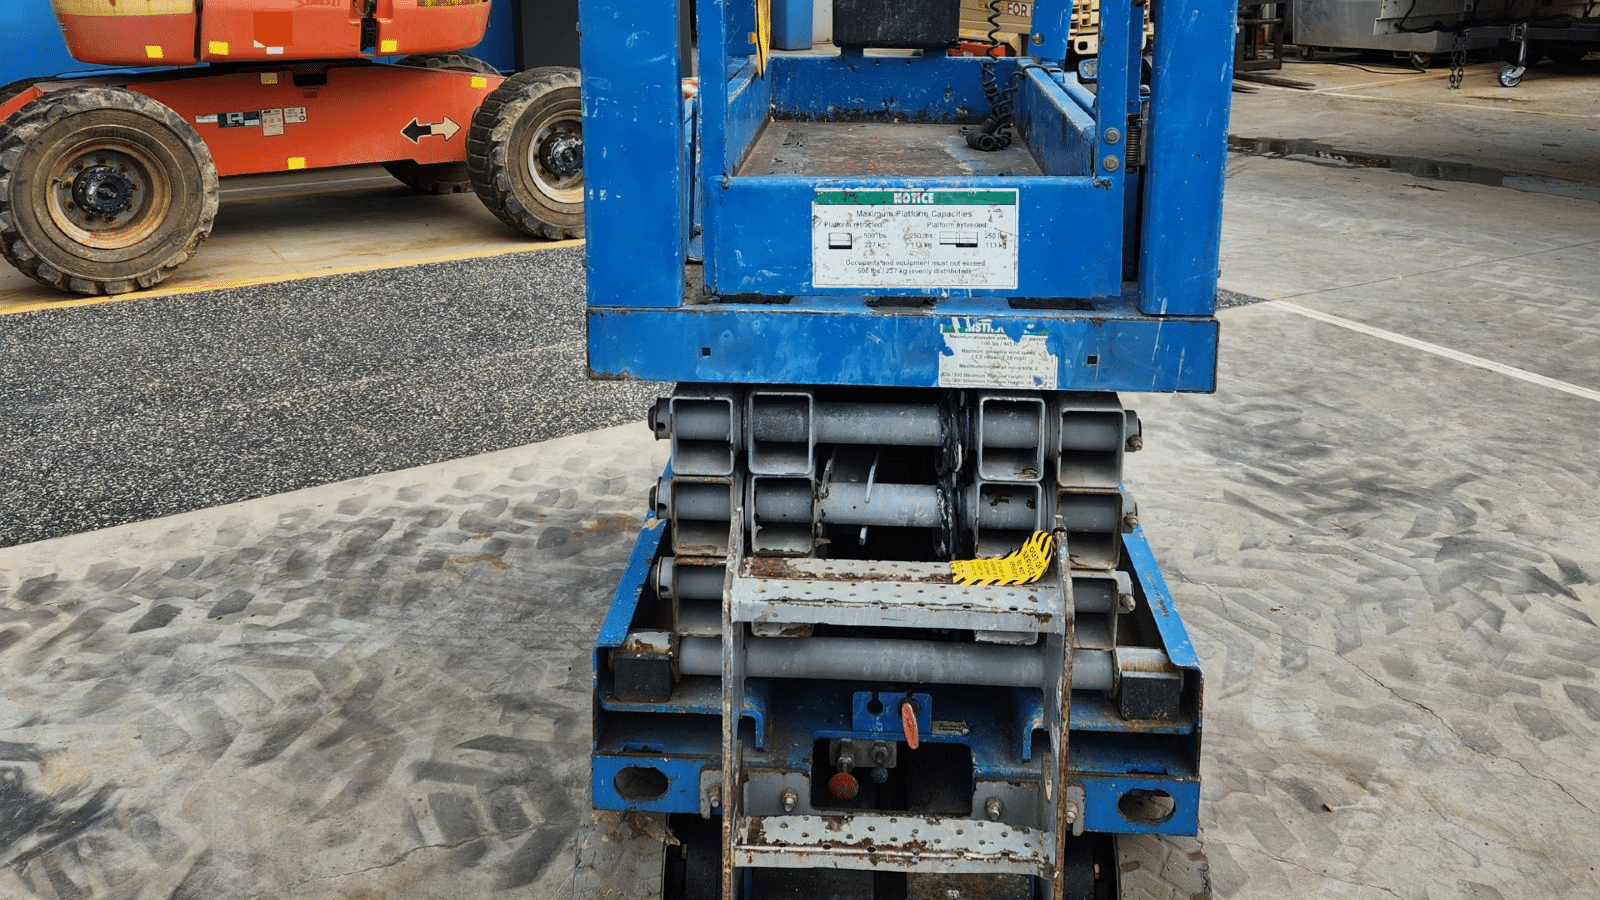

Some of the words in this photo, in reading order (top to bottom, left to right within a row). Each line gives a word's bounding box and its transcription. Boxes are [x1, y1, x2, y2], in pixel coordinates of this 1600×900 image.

[1007, 2, 1027, 17] FOR
[893, 192, 934, 204] NOTICE
[856, 210, 893, 218] Maximum
[896, 210, 929, 218] Platform
[931, 210, 973, 219] Capacities
[845, 259, 880, 267] Occupants
[895, 260, 930, 268] equipment
[899, 268, 908, 276] kg
[908, 268, 932, 276] (evenly
[1022, 551, 1036, 576] SERVICE
[1029, 547, 1039, 562] OUT
[1036, 561, 1043, 570] OF
